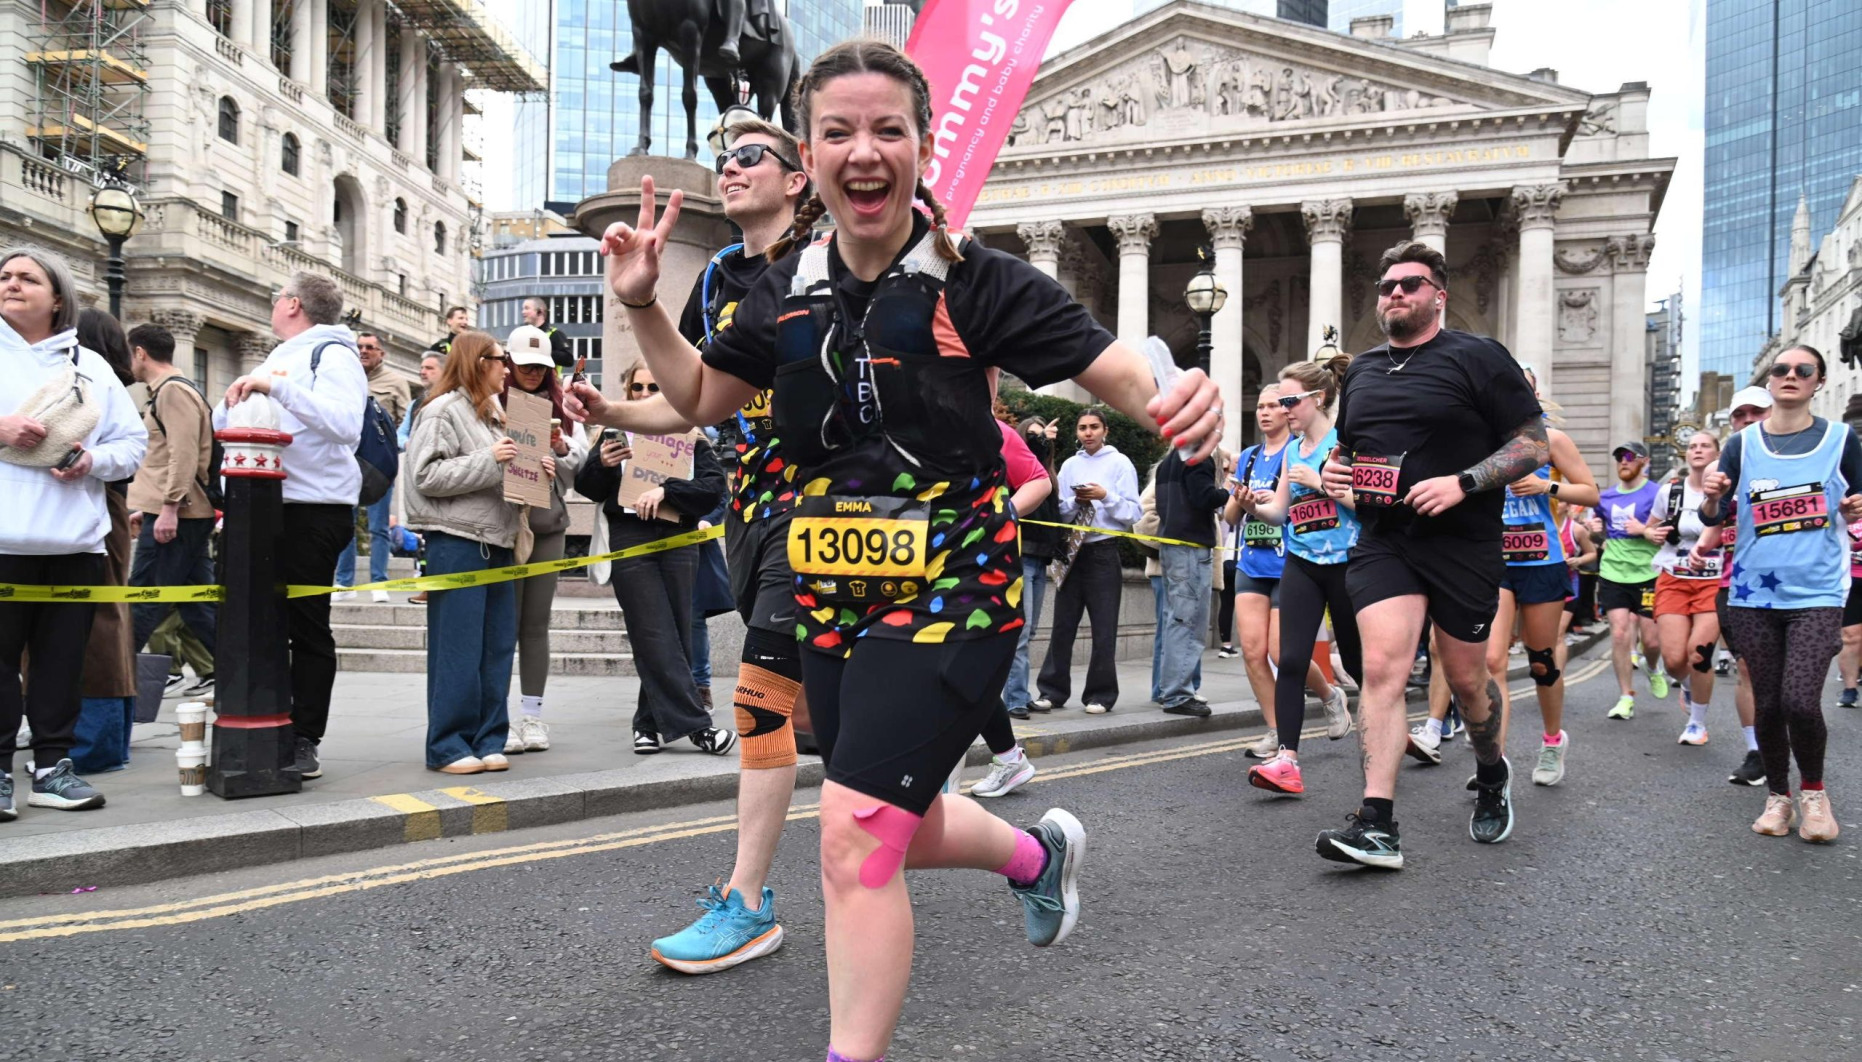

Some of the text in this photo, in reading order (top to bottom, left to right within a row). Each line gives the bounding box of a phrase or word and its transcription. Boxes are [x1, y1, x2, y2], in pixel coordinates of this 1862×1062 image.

[922, 0, 1019, 188] ommy's
[945, 4, 1044, 200] pregnancy and baby charity
[835, 501, 872, 512] EMMA
[1293, 502, 1332, 520] 16011
[1758, 497, 1818, 520] 15681
[797, 528, 916, 566] 13098
[1503, 534, 1544, 549] 6009
